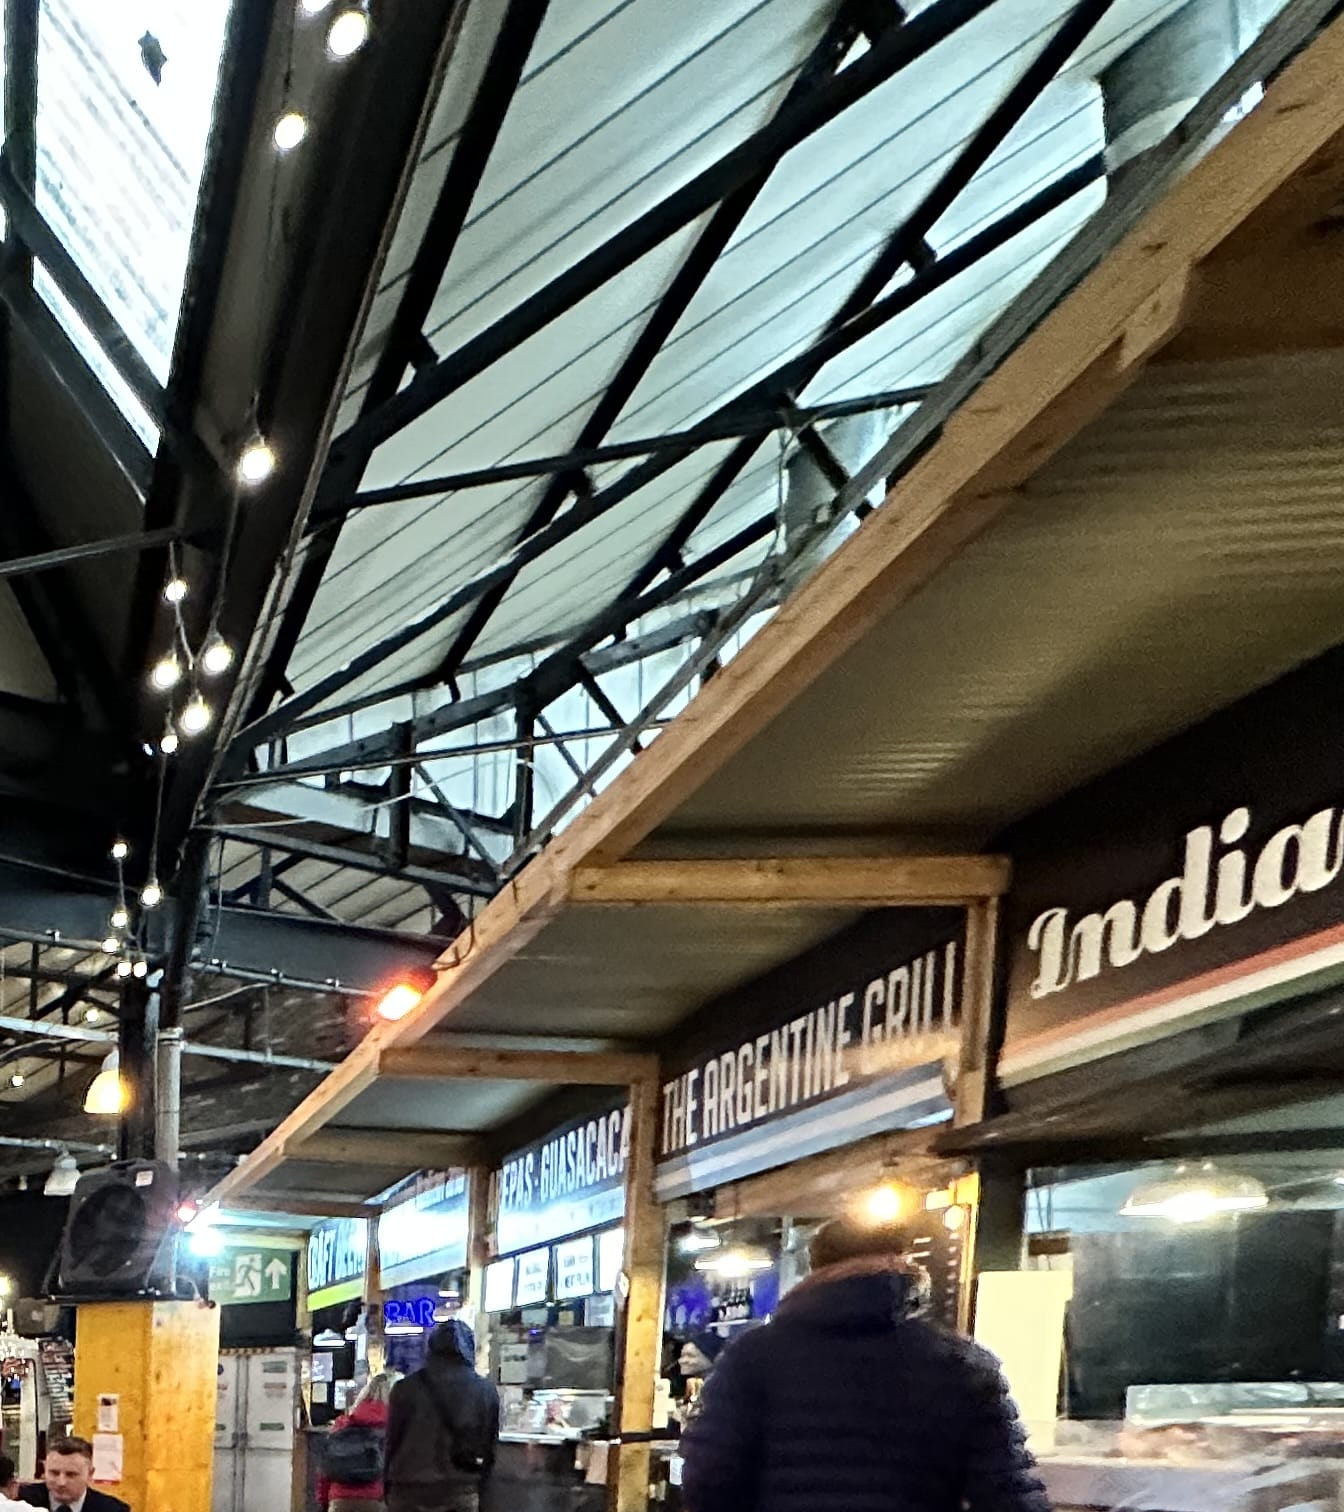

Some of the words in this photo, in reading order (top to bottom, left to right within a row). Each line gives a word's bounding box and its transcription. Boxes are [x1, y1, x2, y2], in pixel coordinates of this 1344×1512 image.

[1028, 807, 1344, 999] India
[663, 1068, 698, 1153] THE
[703, 992, 854, 1139] ARGENTINE
[862, 941, 961, 1072] GRILL
[385, 1298, 435, 1327] BAR
